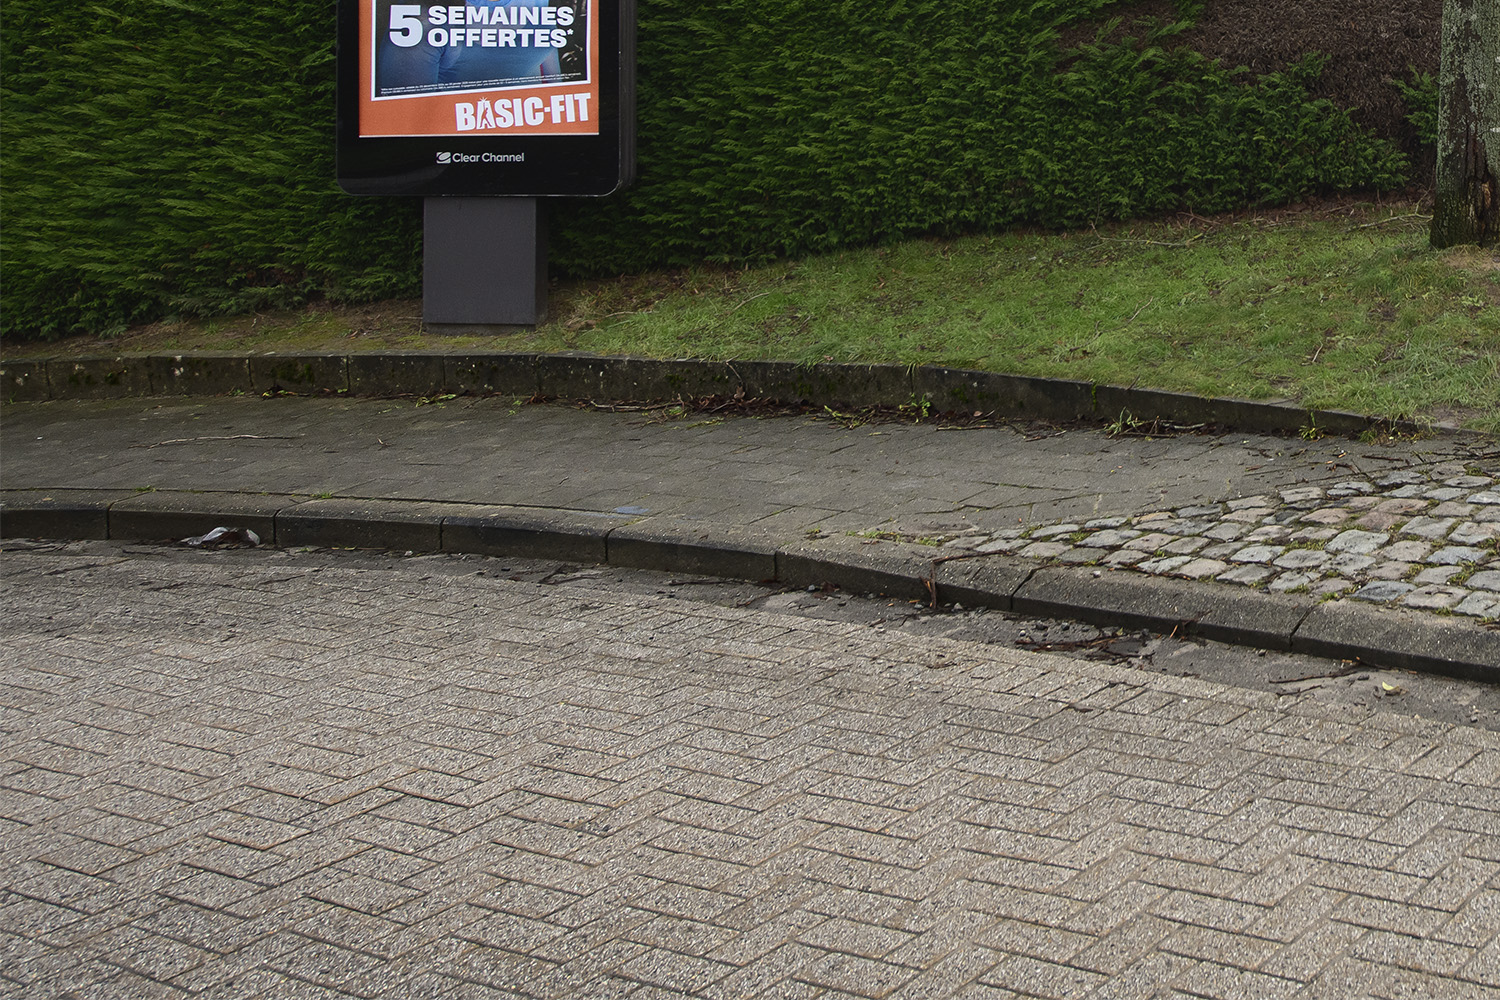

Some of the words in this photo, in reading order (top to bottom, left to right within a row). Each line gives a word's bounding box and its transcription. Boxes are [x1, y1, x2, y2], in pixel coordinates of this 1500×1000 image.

[389, 4, 423, 47] 5
[428, 5, 574, 26] SEMAINES
[455, 92, 591, 131] BASIC-FIT
[452, 152, 480, 163] Clear
[481, 152, 525, 163] Channel
